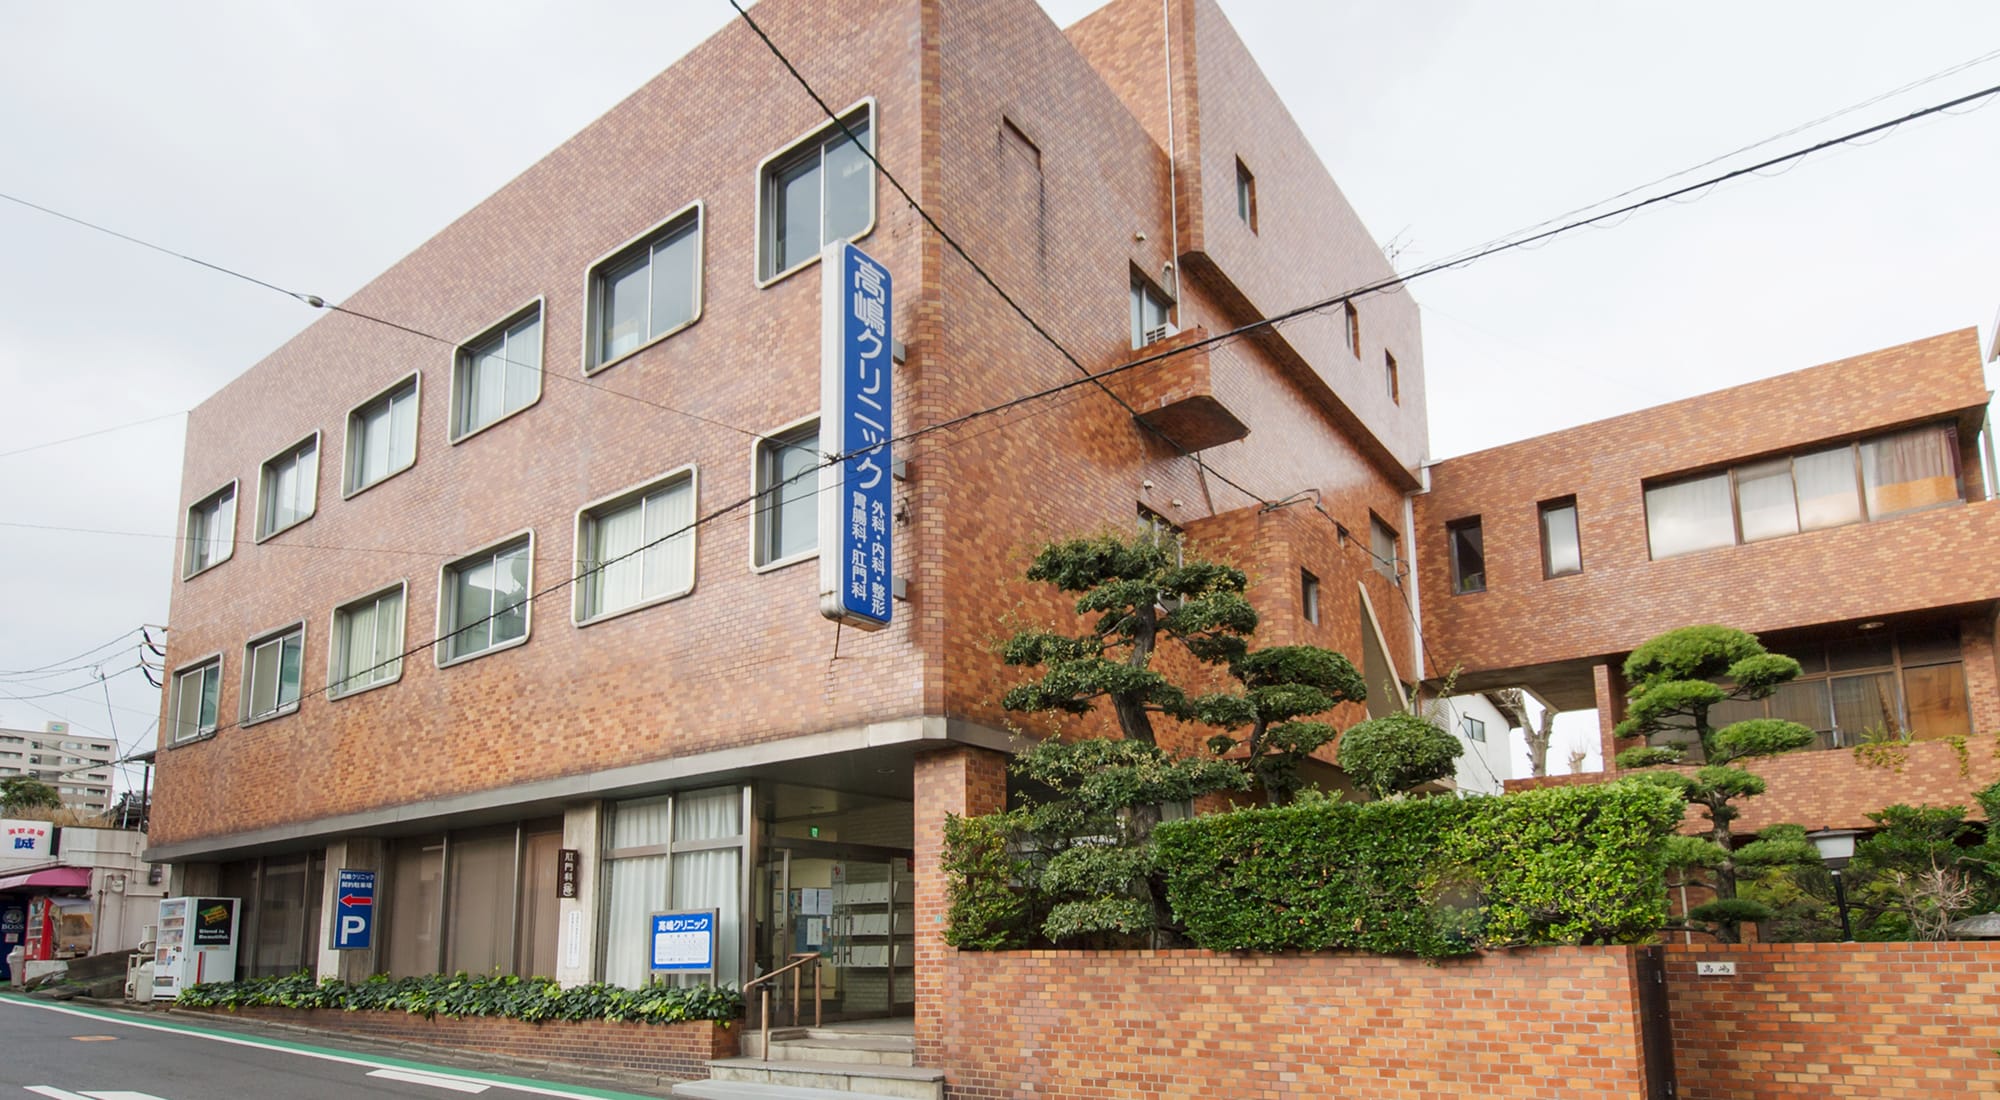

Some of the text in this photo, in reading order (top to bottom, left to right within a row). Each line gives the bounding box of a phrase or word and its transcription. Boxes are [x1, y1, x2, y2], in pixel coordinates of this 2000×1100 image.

[853, 255, 886, 488] 高嶋クリニック
[851, 491, 867, 601] 胃腸科・肛門科
[871, 500, 886, 616] 外科・内科・整形
[340, 915, 366, 945] P
[658, 918, 708, 931] 高嶋クリニック
